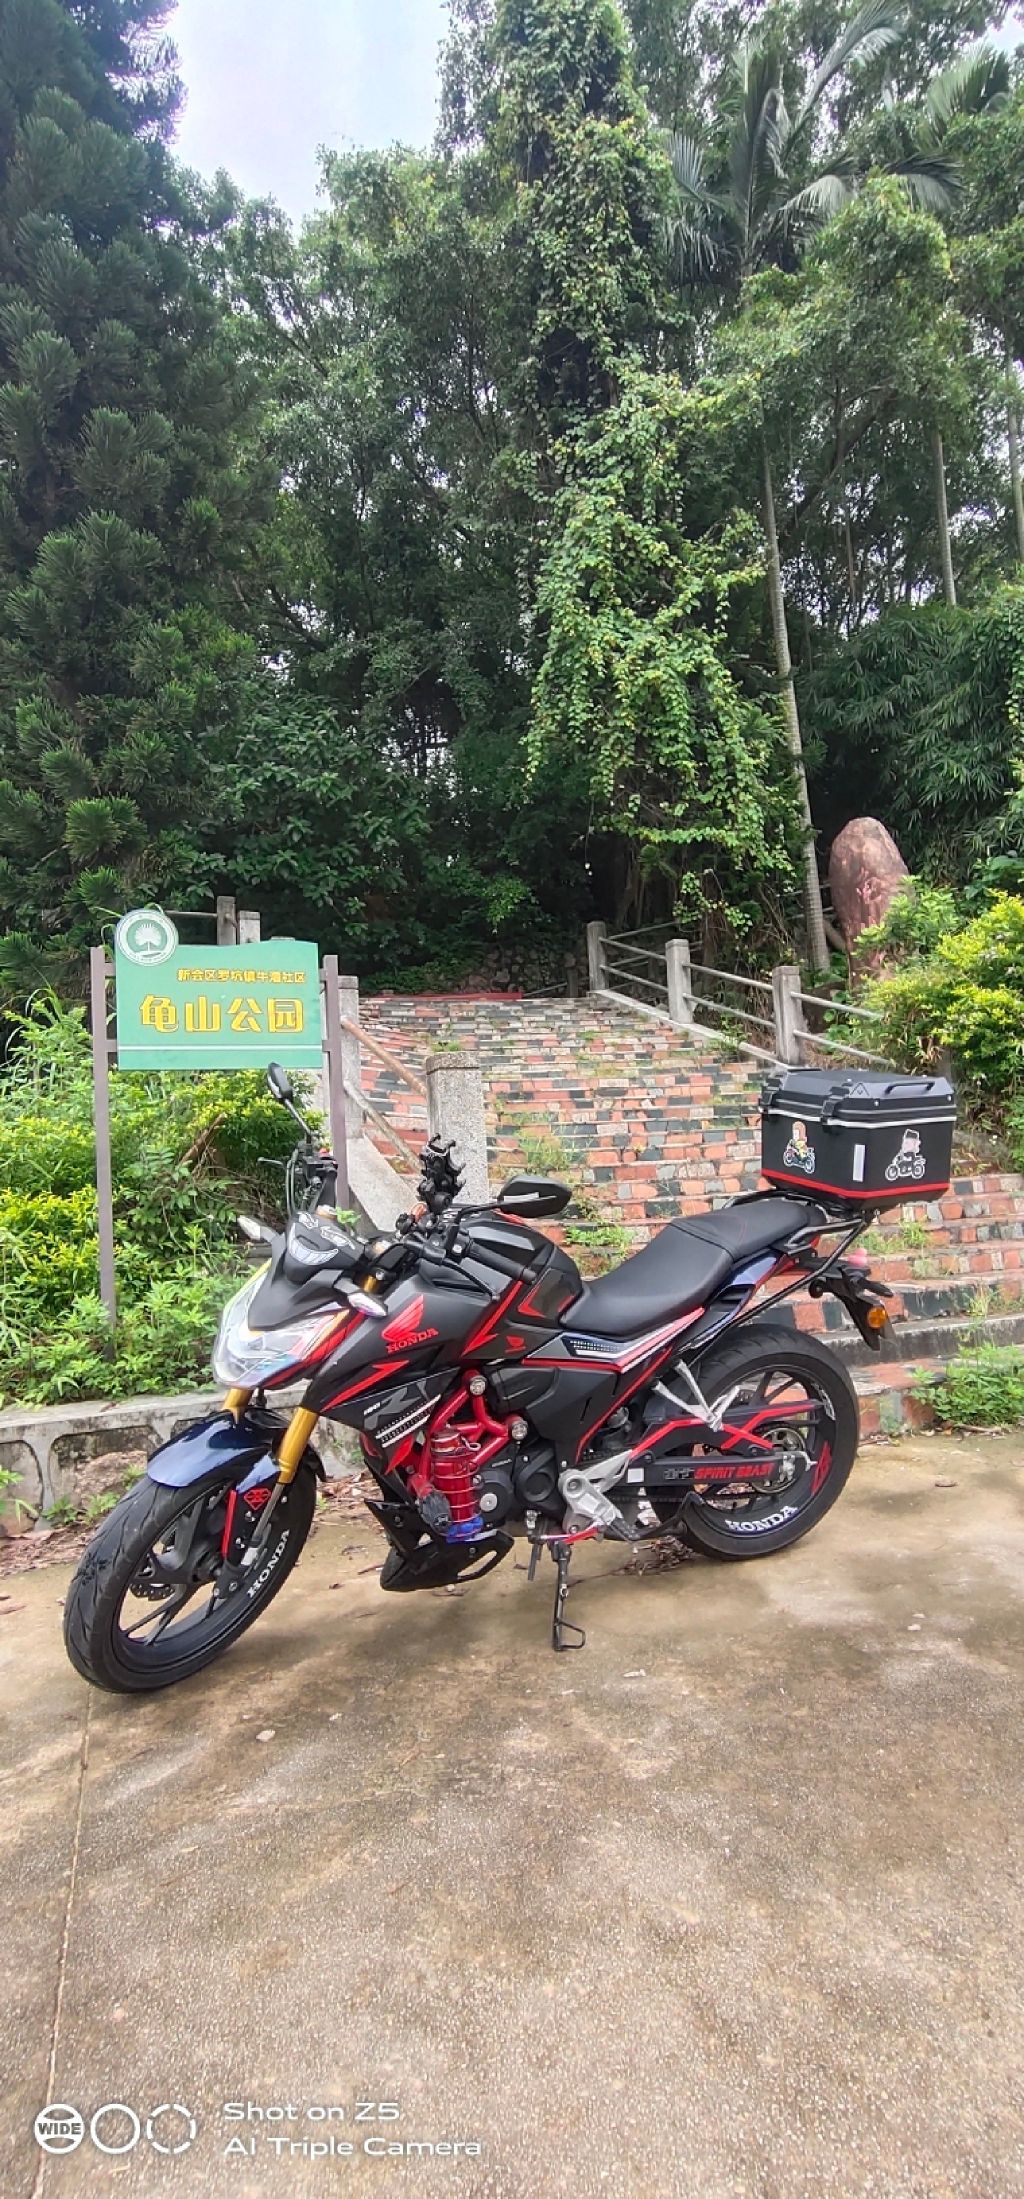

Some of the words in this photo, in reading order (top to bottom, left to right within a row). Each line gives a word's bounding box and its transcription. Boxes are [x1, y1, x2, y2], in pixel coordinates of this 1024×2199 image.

[139, 994, 304, 1033] 龟山公园
[385, 1328, 439, 1353] HONDA
[694, 1466, 736, 1480] SPIRIT
[725, 1505, 799, 1532] HONDA
[246, 1529, 290, 1598] HONDA
